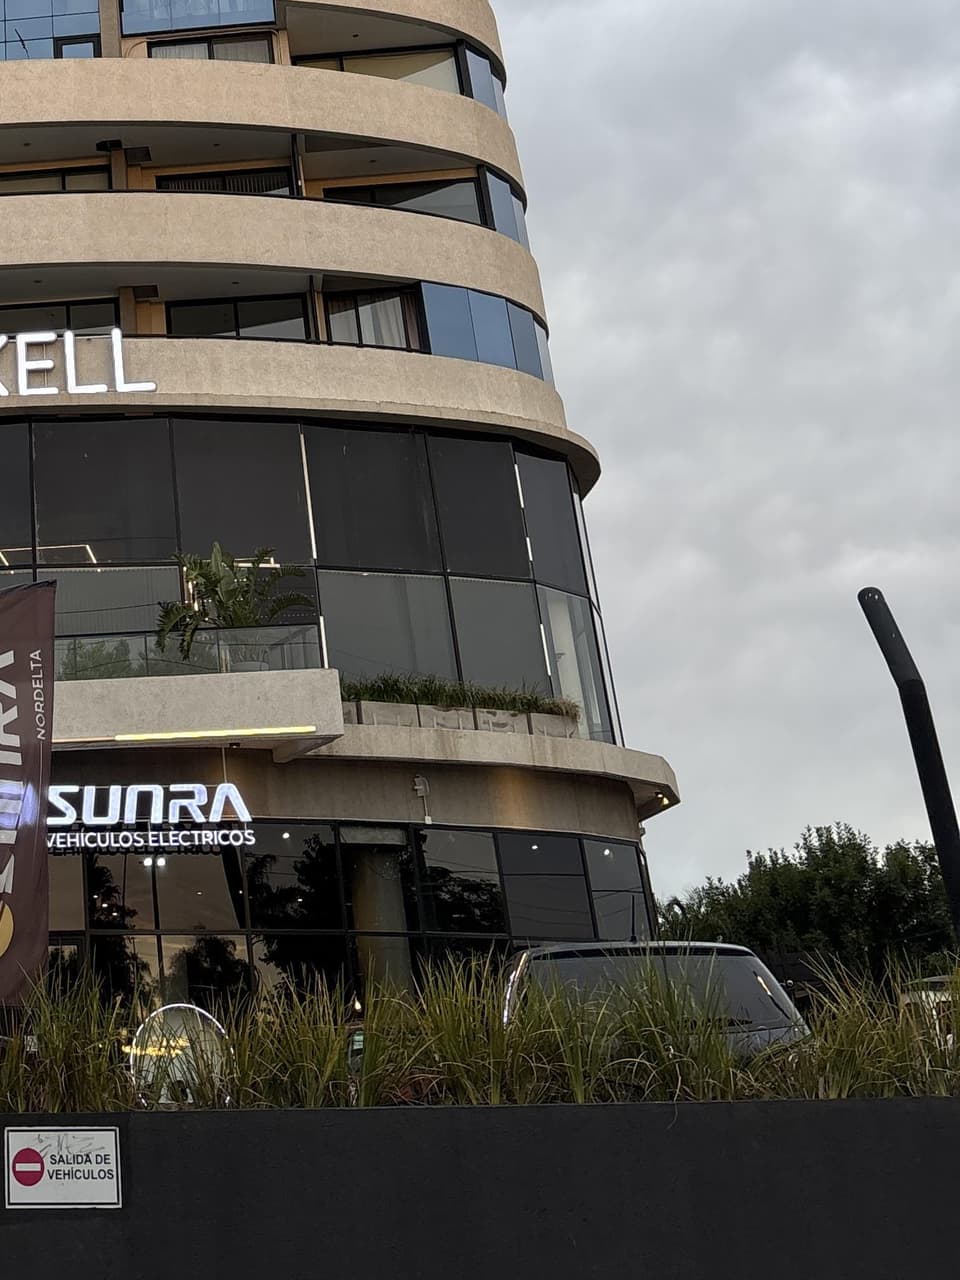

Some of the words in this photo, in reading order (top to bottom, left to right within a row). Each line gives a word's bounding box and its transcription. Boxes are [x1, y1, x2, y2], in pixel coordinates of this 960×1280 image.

[29, 649, 46, 740] NORDELTA
[46, 783, 253, 825] SUNRA
[49, 1153, 93, 1165] SALIDA
[96, 1153, 111, 1165] DE
[47, 1167, 114, 1180] VEHÍCULOS
